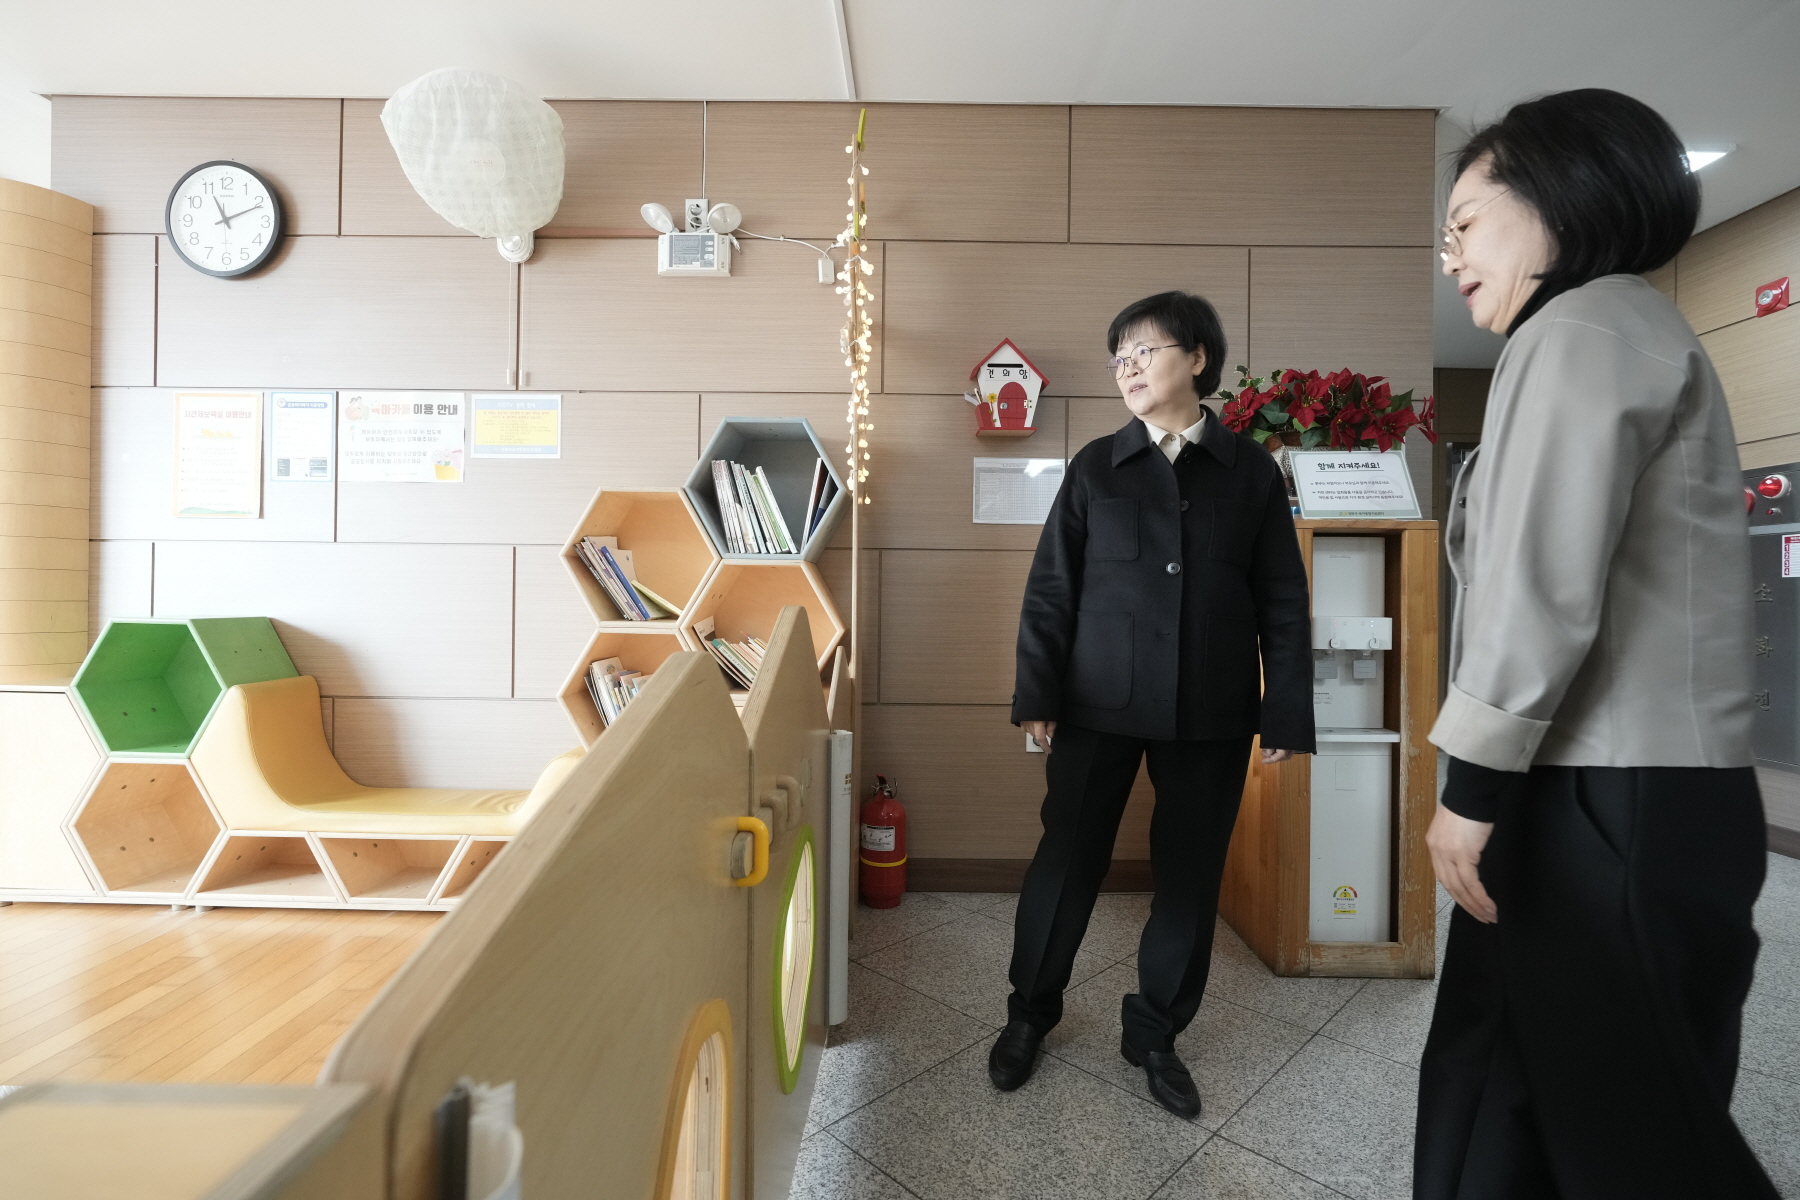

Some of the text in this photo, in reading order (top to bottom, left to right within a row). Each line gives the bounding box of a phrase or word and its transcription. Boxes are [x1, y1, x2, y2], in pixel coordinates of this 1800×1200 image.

[202, 182, 214, 194] 11
[219, 176, 234, 190] 12
[243, 182, 248, 196] 1
[187, 196, 202, 209] 10
[254, 196, 264, 208] 2
[182, 214, 193, 228] 9
[260, 215, 271, 228] 3
[189, 232, 200, 246] 8
[252, 232, 263, 246] 4
[204, 246, 214, 260] 7
[221, 252, 232, 266] 6
[240, 248, 250, 261] 5
[225, 410, 252, 419] 이용안내
[413, 404, 434, 416] 이용
[437, 404, 459, 416] 안내
[1317, 462, 1381, 471] 함께 지켜주세요!
[1753, 583, 1774, 712] 소화전
